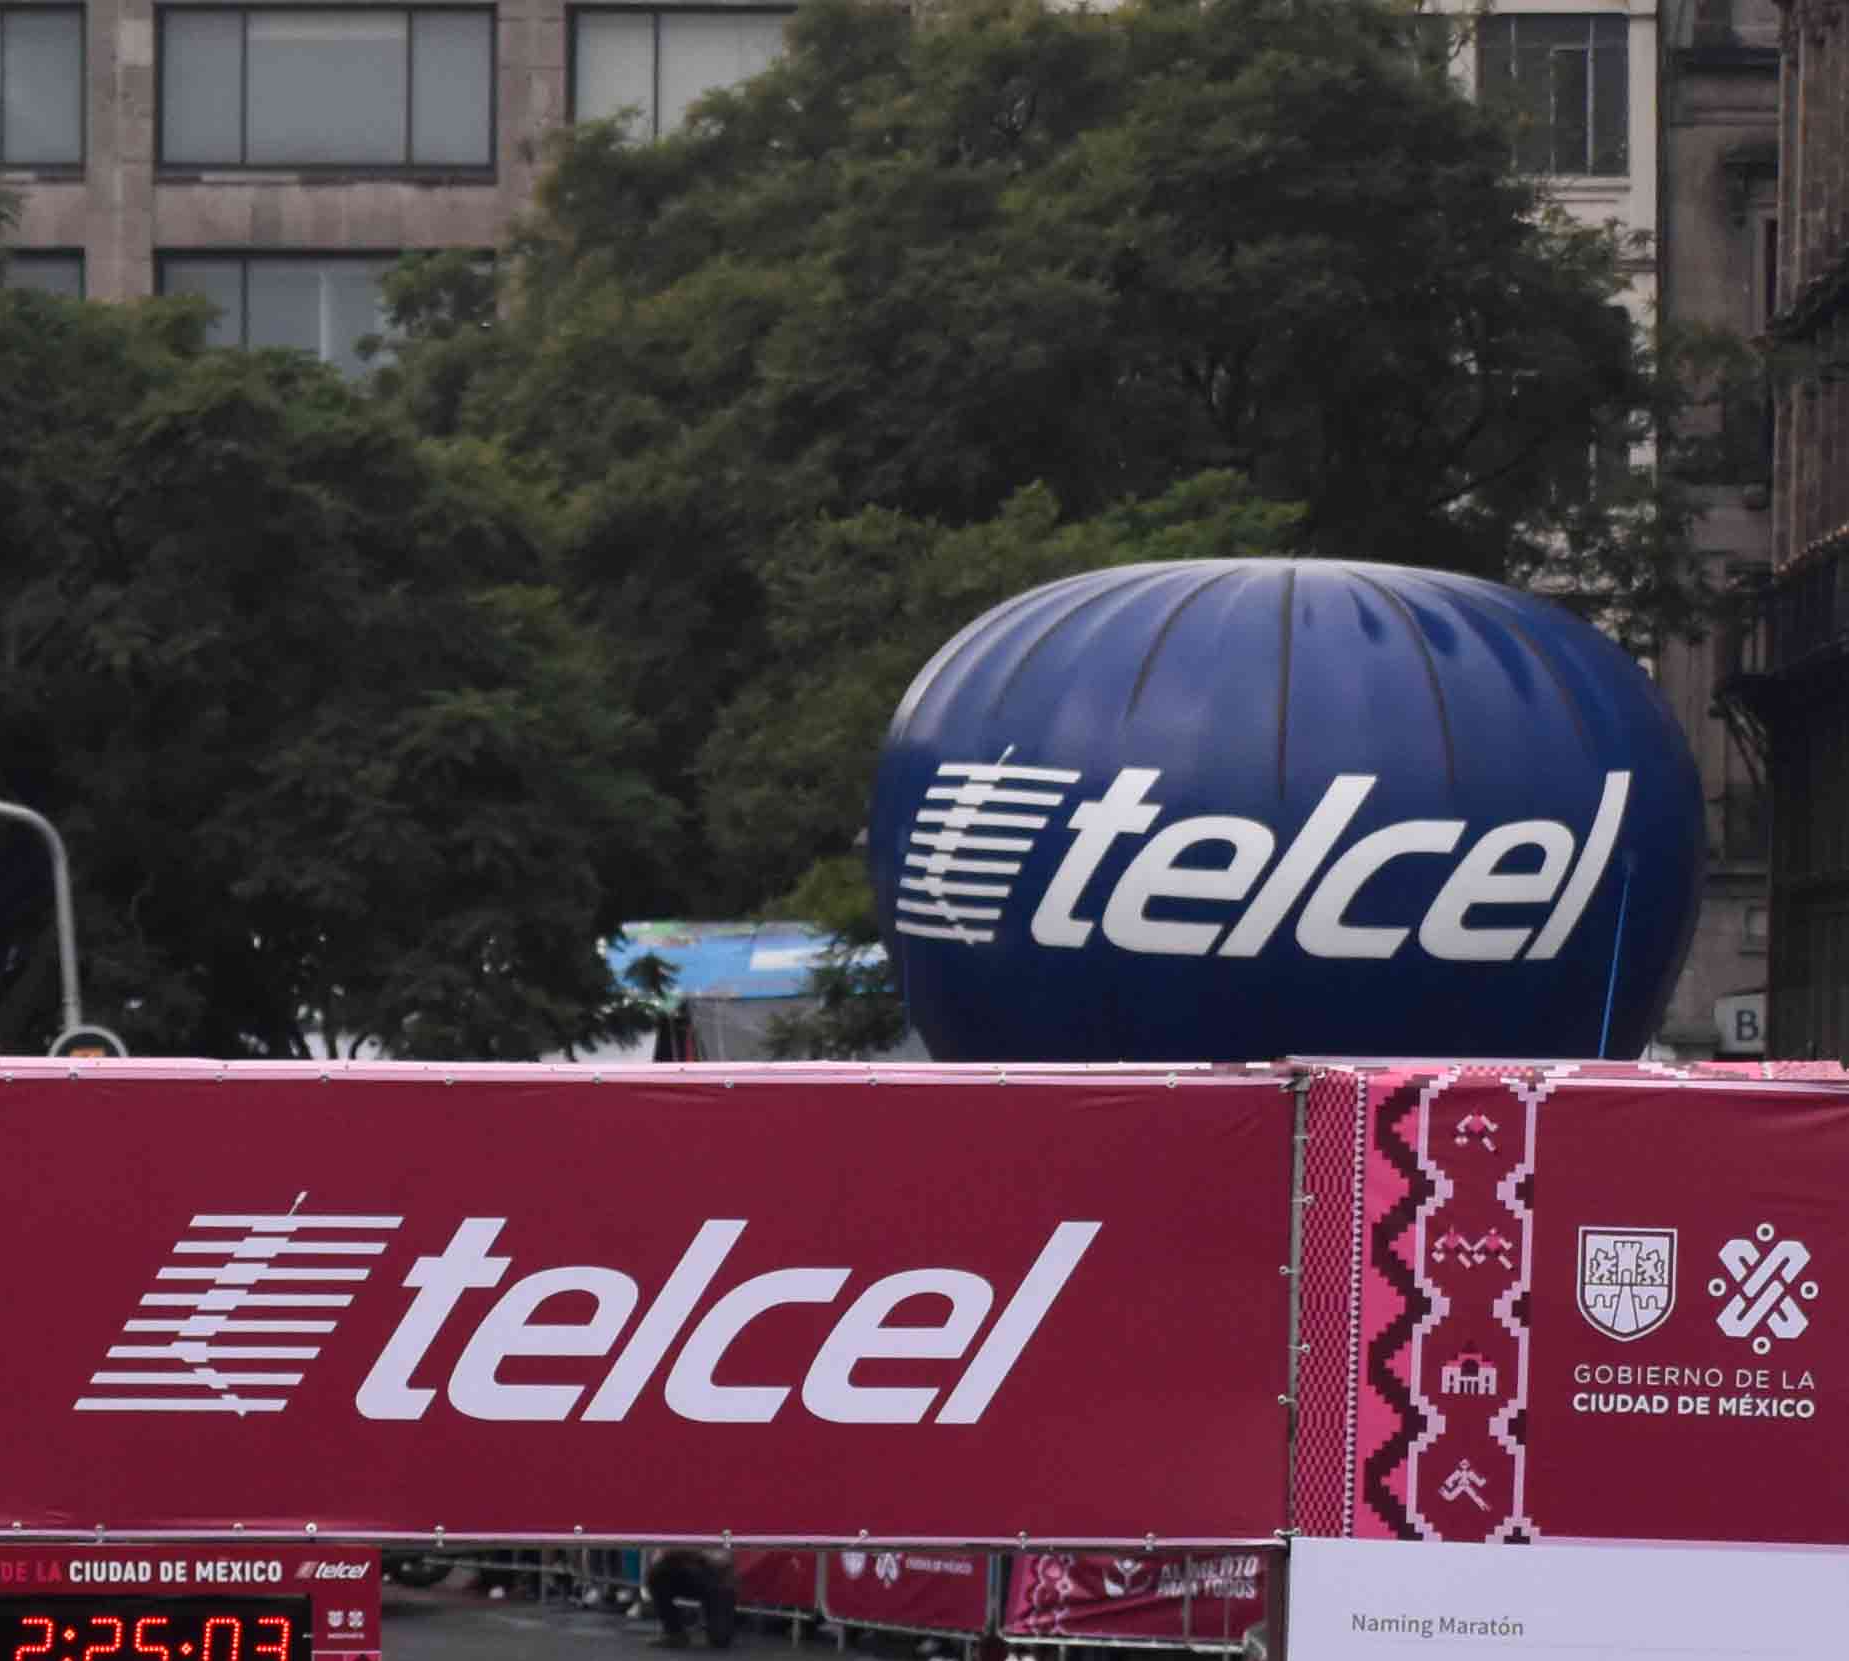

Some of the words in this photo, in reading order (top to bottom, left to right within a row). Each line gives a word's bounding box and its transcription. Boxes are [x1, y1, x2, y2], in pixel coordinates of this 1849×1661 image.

[1030, 768, 1631, 960] telcel
[355, 1216, 1103, 1424] telcel
[1573, 1364, 1723, 1387] GOBIERNO
[1735, 1369, 1768, 1389] DE
[1781, 1371, 1815, 1390] LA
[1572, 1393, 1669, 1414] CIUDAD
[1677, 1395, 1710, 1415] DE
[1717, 1391, 1815, 1418] MÉXICO
[69, 1561, 151, 1583] CIUDAD
[159, 1561, 188, 1583] DE
[314, 1560, 371, 1579] telcel
[1351, 1613, 1434, 1638] Naming
[1438, 1615, 1524, 1636] Maratón
